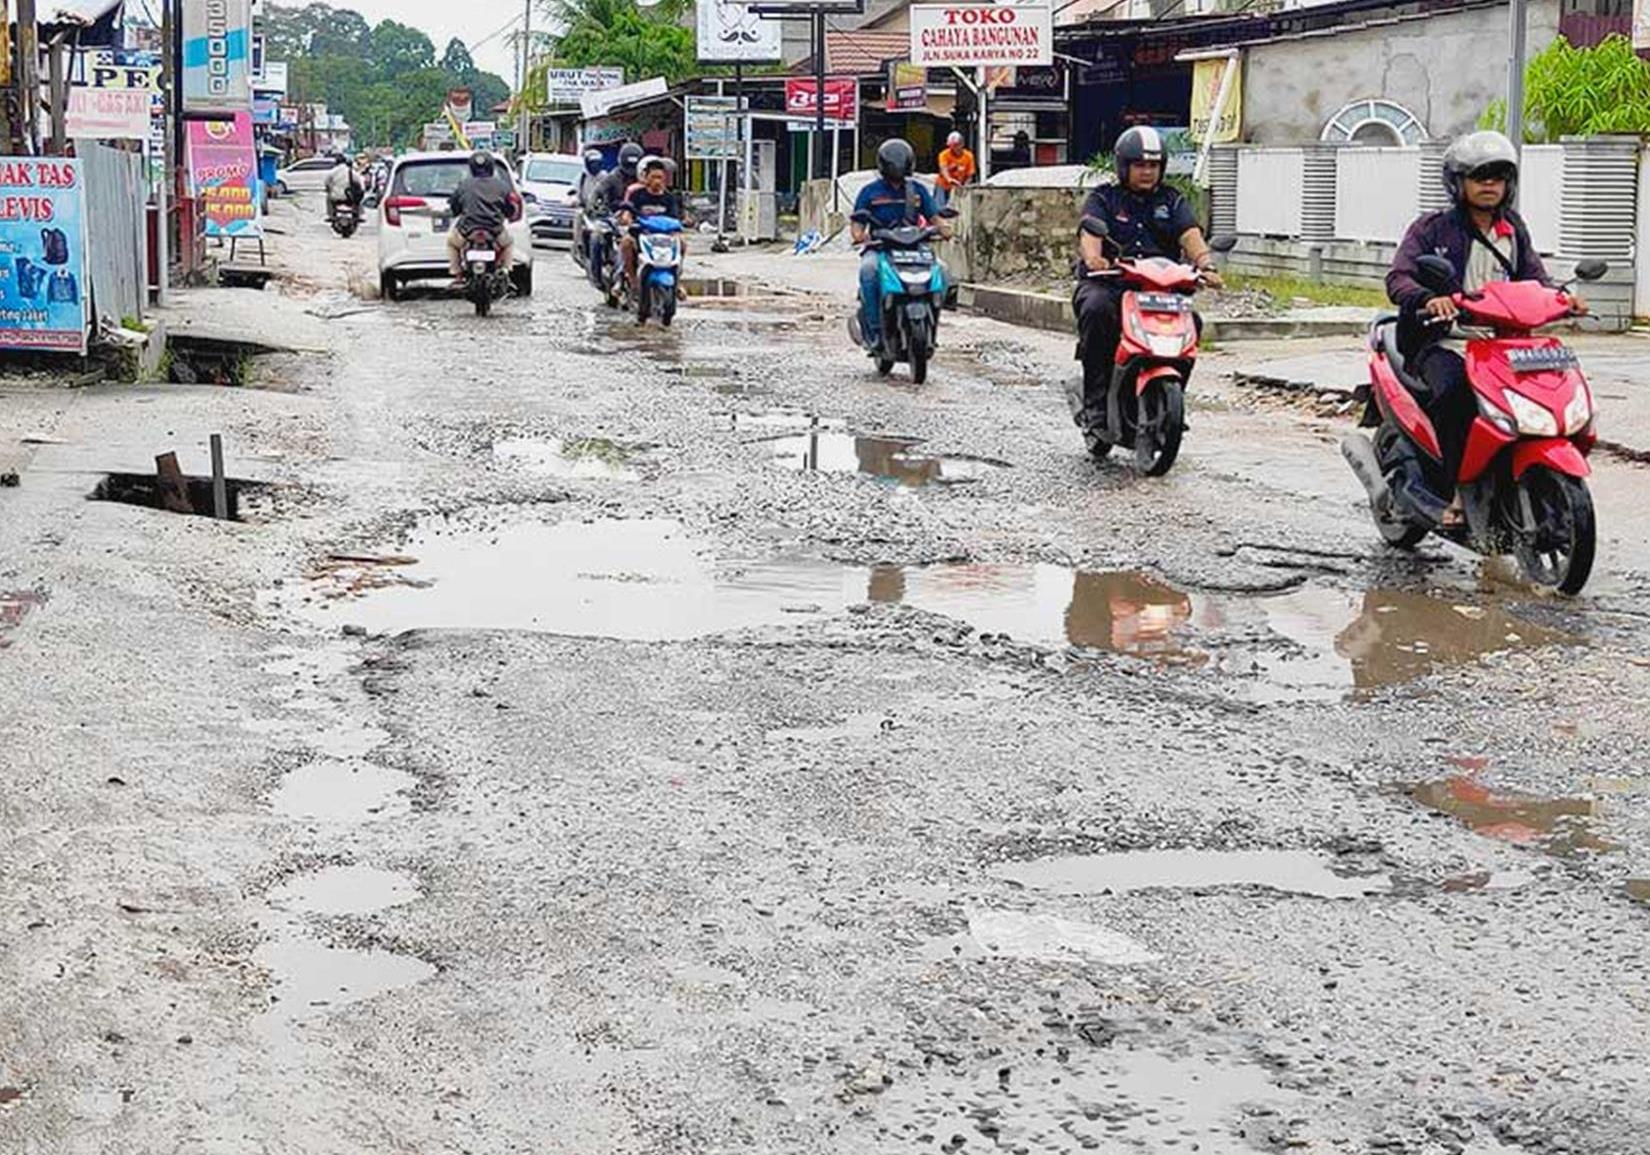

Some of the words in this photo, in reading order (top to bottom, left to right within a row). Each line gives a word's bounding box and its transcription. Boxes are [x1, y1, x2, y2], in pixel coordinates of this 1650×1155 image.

[944, 8, 1016, 24] TOKO
[921, 28, 971, 47] CAHAYA
[972, 26, 1039, 46] BANGUNAN
[973, 50, 1006, 60] KARYA
[1026, 48, 1039, 59] 22
[550, 71, 582, 79] URUT
[37, 163, 76, 190] TAS
[196, 164, 249, 183] PROMO
